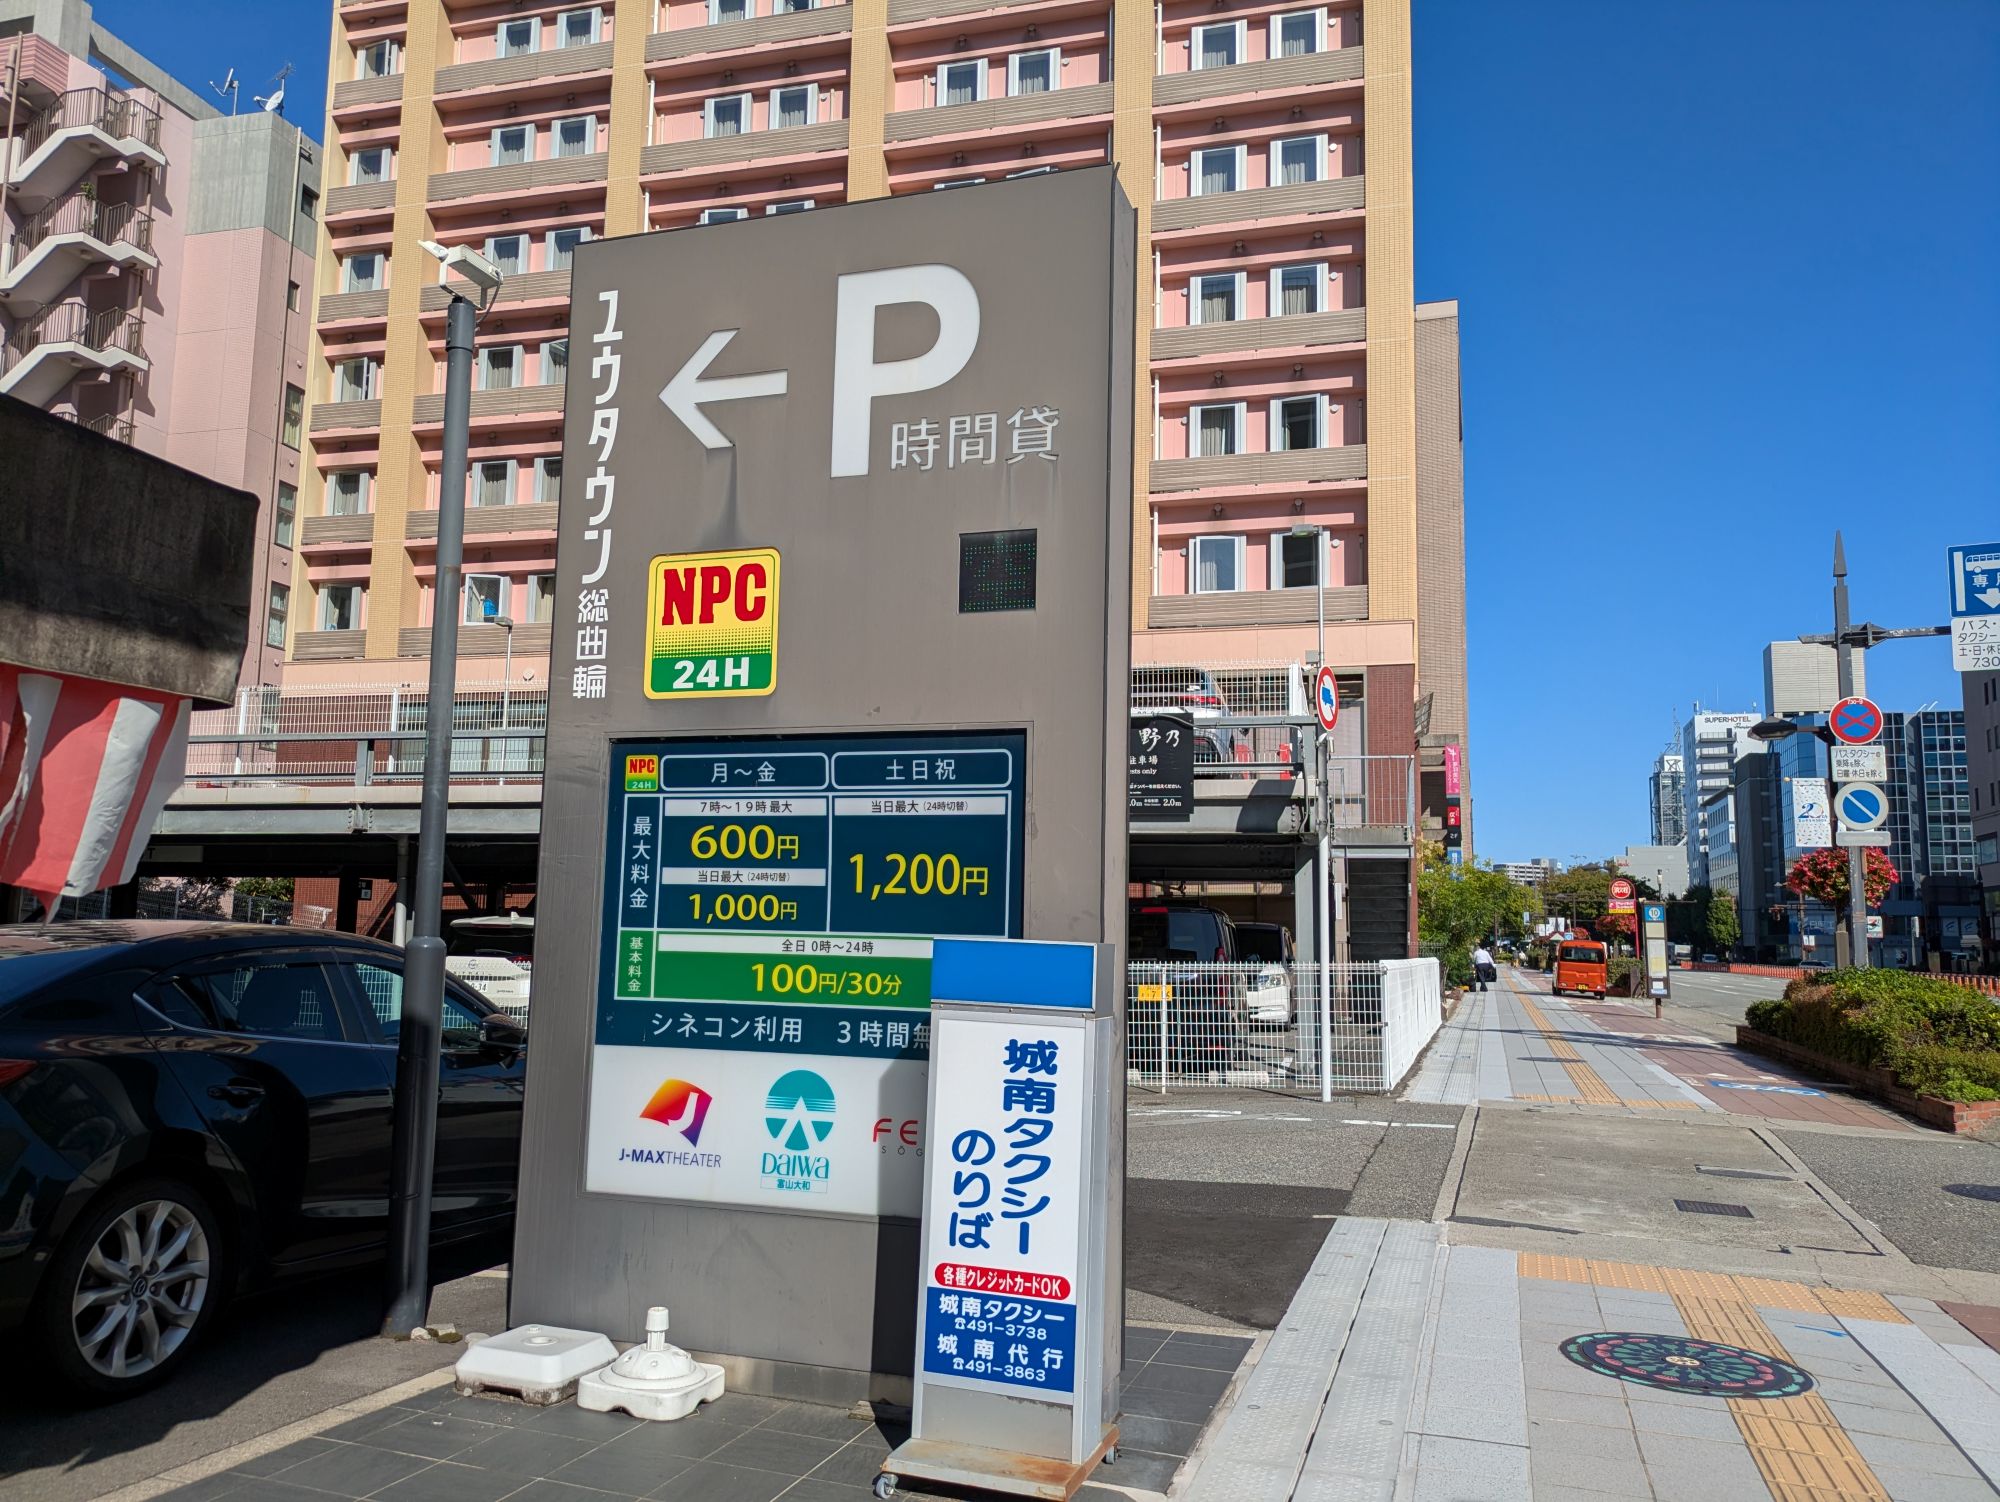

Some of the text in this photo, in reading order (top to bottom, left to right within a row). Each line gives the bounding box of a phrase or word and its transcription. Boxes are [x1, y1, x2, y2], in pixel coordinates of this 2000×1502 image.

[830, 263, 981, 479] P
[890, 406, 1061, 472] 時間貸
[661, 562, 768, 627] NPC
[1958, 632, 1997, 643] タクシー
[672, 656, 750, 690] 24H
[1704, 716, 1752, 724] SUPERHOTEL
[1138, 727, 1180, 752] 野乃
[629, 759, 656, 774] NPC
[885, 758, 957, 782] 土日祝
[1142, 768, 1158, 776] only
[632, 781, 652, 790] 24H
[870, 801, 920, 815] 当日最大
[1162, 798, 1182, 807] 2.0m
[690, 824, 800, 860] 600円
[629, 816, 653, 909] 最大料金
[697, 870, 744, 883] 当日最大
[849, 853, 989, 902] 1,200円
[688, 893, 798, 925] 1,000円
[1650, 907, 1660, 917] 10
[781, 938, 806, 953] 全日
[627, 936, 645, 993] 基本料金
[750, 963, 903, 997] 100円/30分
[651, 1012, 803, 1044] シネコン利用
[618, 1147, 722, 1168] J-MAXTHEATER
[1001, 1037, 1059, 1256] 城南タクシー
[776, 1178, 811, 1191] 富山大和
[948, 1128, 996, 1250] のりば
[943, 1265, 1062, 1297] 各種クレジットカードOK
[939, 1293, 1066, 1324] 城南タクシー
[966, 1319, 1048, 1341] 491-3738
[937, 1333, 1064, 1370] 城南代行
[965, 1359, 1046, 1382] 491-3863
